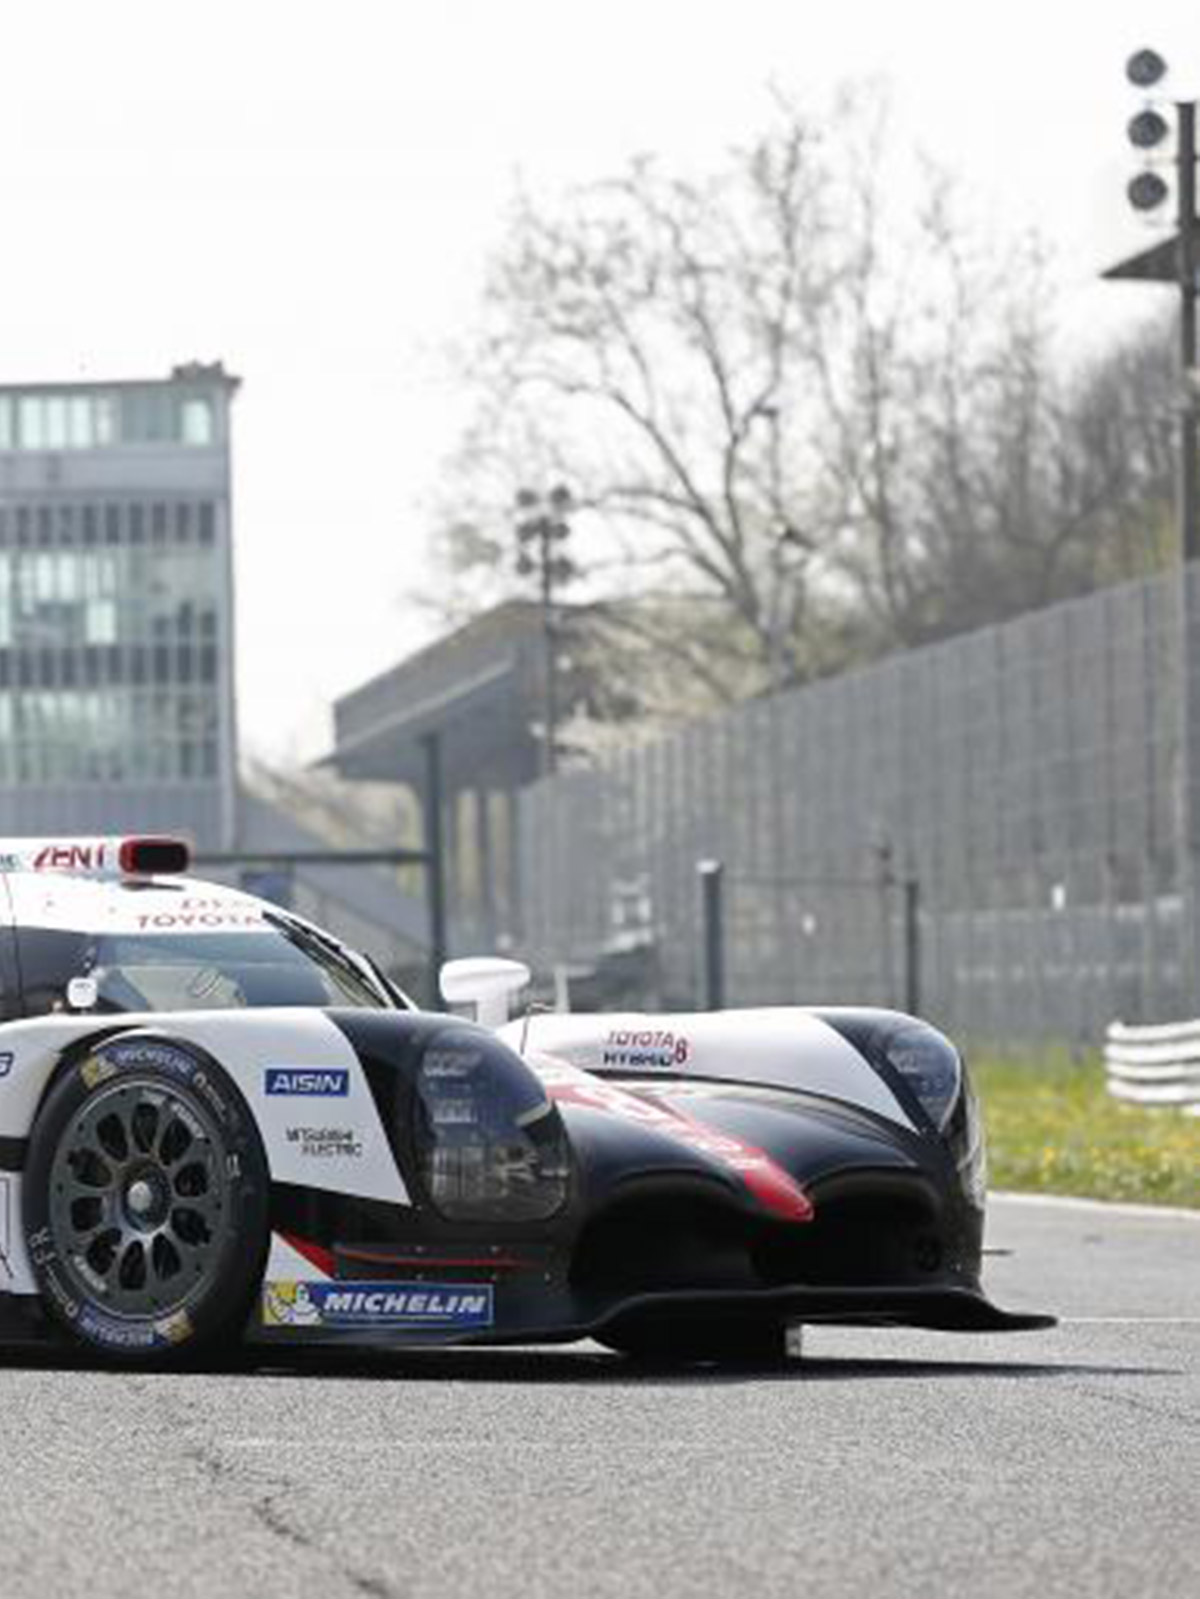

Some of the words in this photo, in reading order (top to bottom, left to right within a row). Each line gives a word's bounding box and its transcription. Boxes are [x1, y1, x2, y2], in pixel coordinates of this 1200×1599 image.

[608, 1031, 673, 1047] TOYOTA
[675, 1036, 688, 1064] 8
[603, 1051, 673, 1067] HYBRID
[272, 1074, 344, 1092] AISIN
[324, 1293, 487, 1313] MICHELIN
